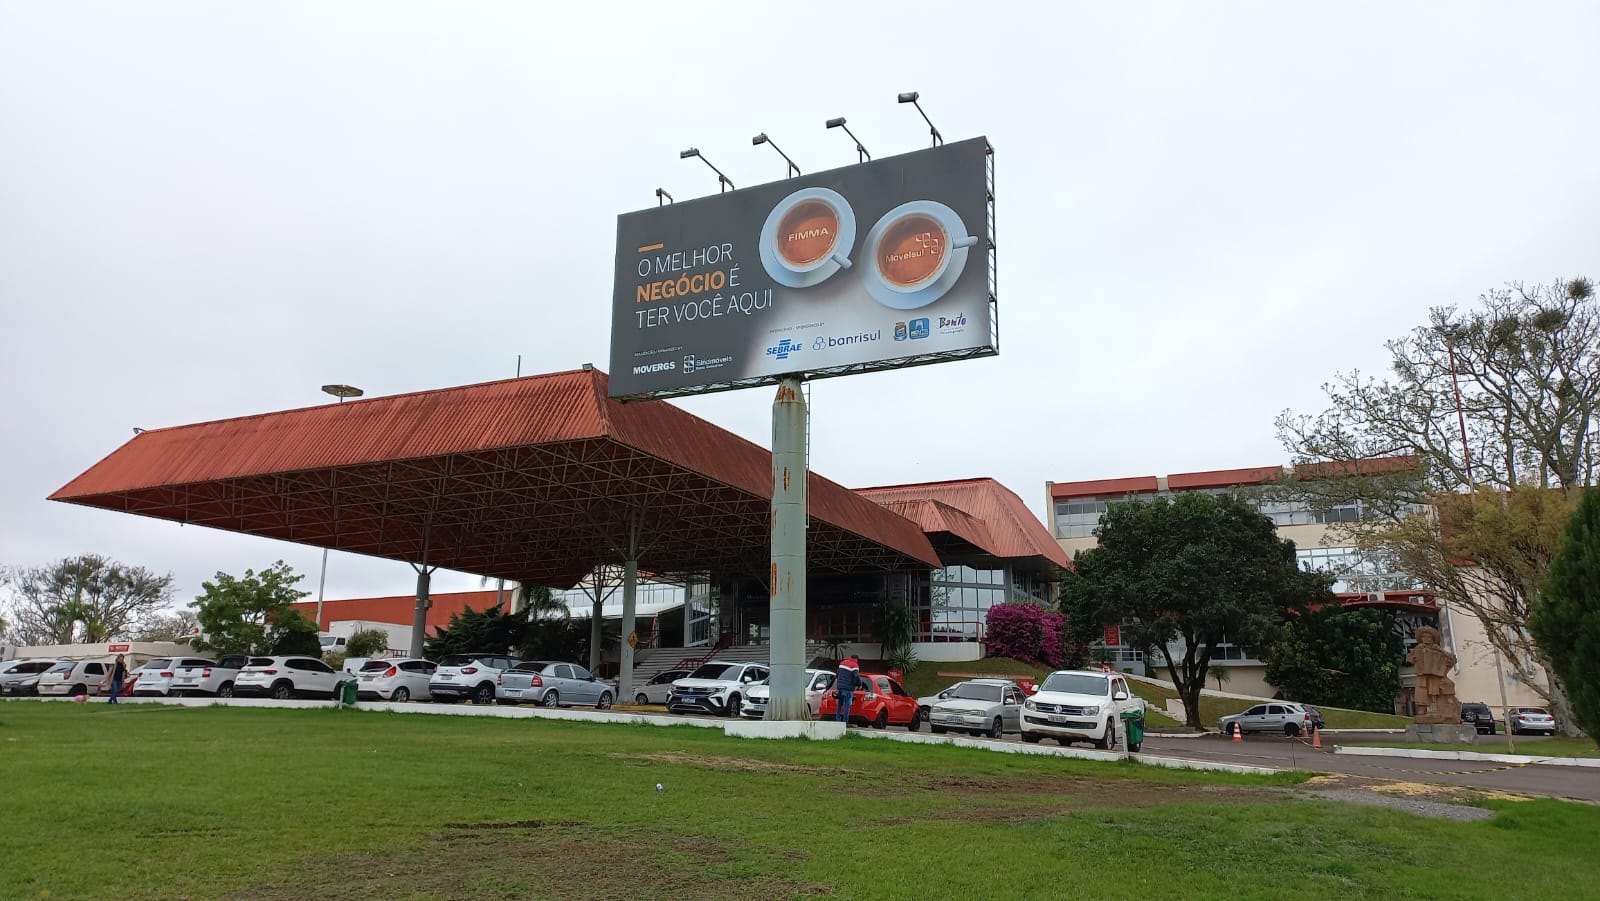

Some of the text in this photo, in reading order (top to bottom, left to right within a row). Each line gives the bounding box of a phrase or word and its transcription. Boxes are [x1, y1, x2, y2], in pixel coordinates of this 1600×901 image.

[788, 227, 829, 242] FIMMA
[638, 243, 733, 277] O MELHOR
[885, 249, 925, 263] Movelsul
[636, 263, 741, 304] NEGÓCIO É
[636, 288, 772, 329] TER VOCÊ AQUI
[828, 329, 881, 347] banrisul
[766, 343, 803, 356] SEBRAE
[632, 361, 676, 375] MOVERGS
